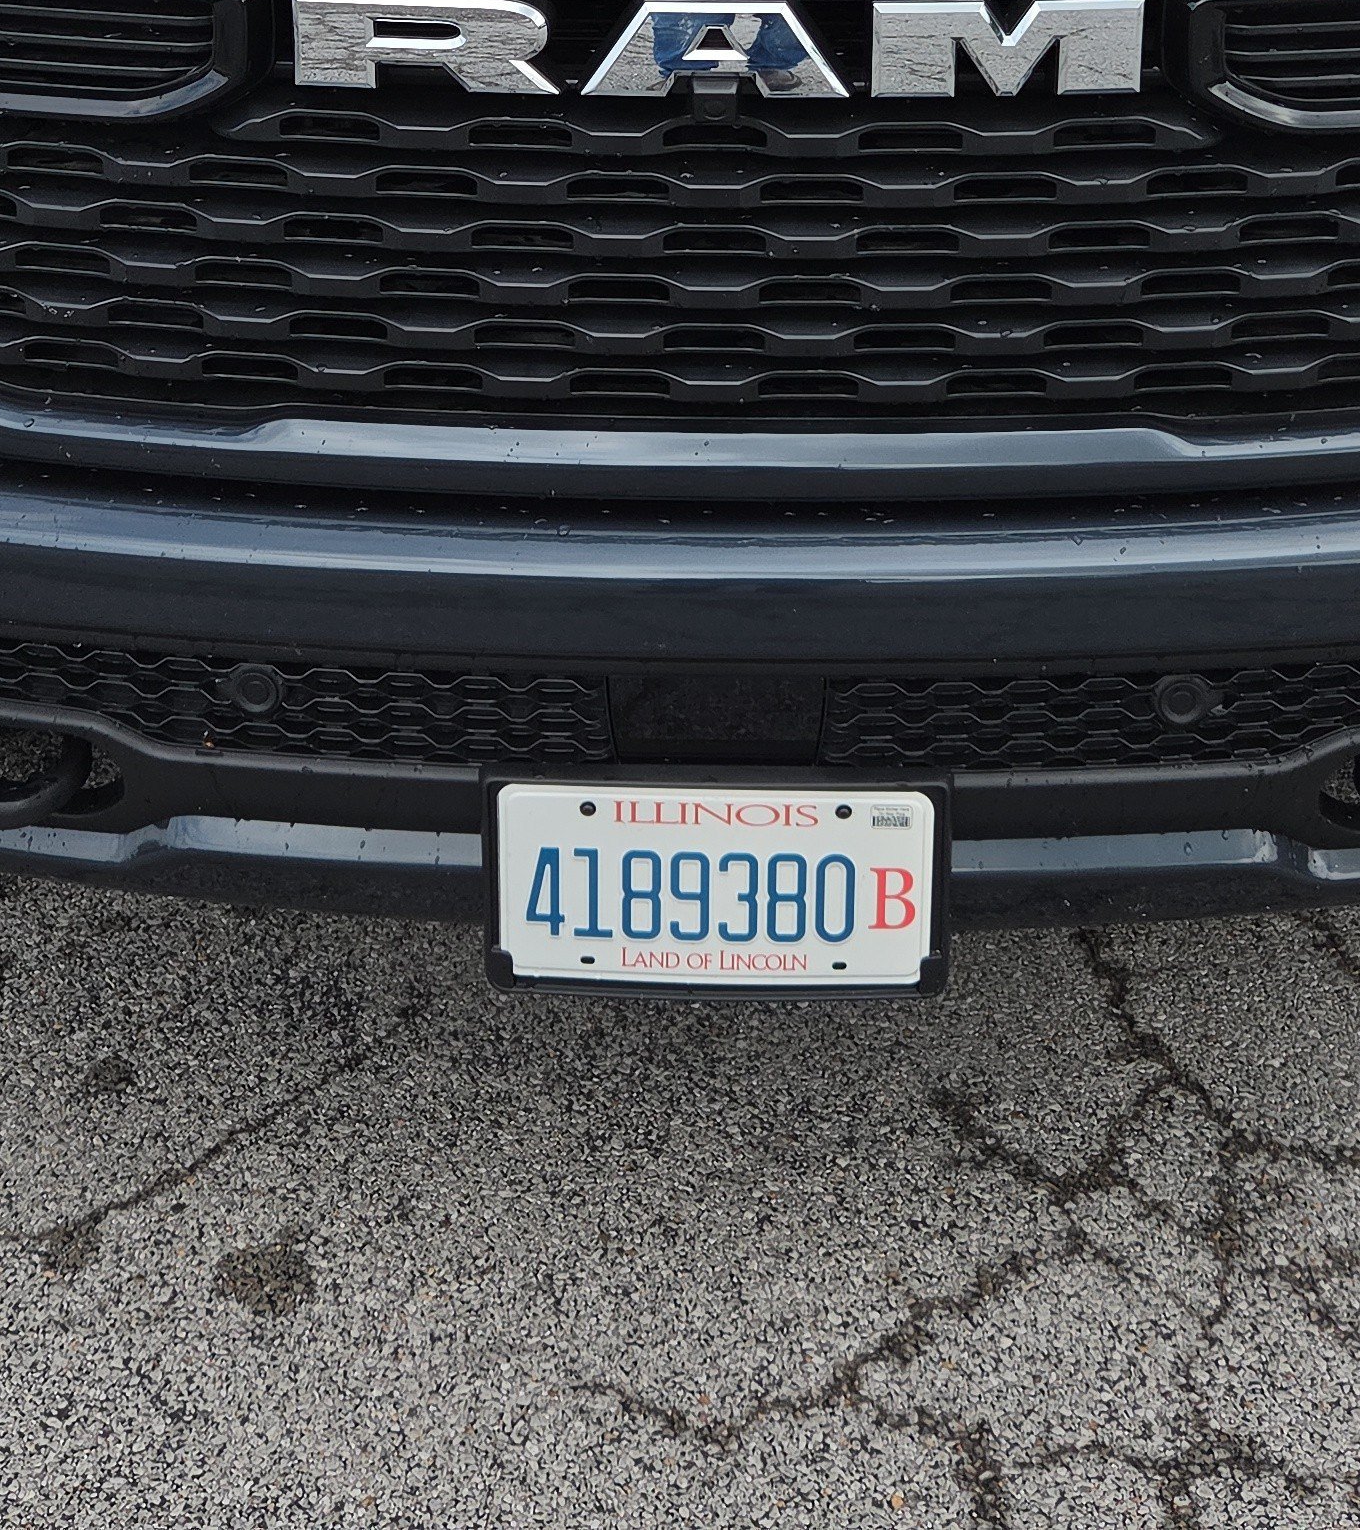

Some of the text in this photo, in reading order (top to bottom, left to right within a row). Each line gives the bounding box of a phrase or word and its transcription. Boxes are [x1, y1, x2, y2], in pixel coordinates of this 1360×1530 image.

[613, 800, 819, 828] ILLINOIS
[525, 846, 916, 943] 4189380 B
[621, 946, 808, 972] LAND OF LINCOLN
